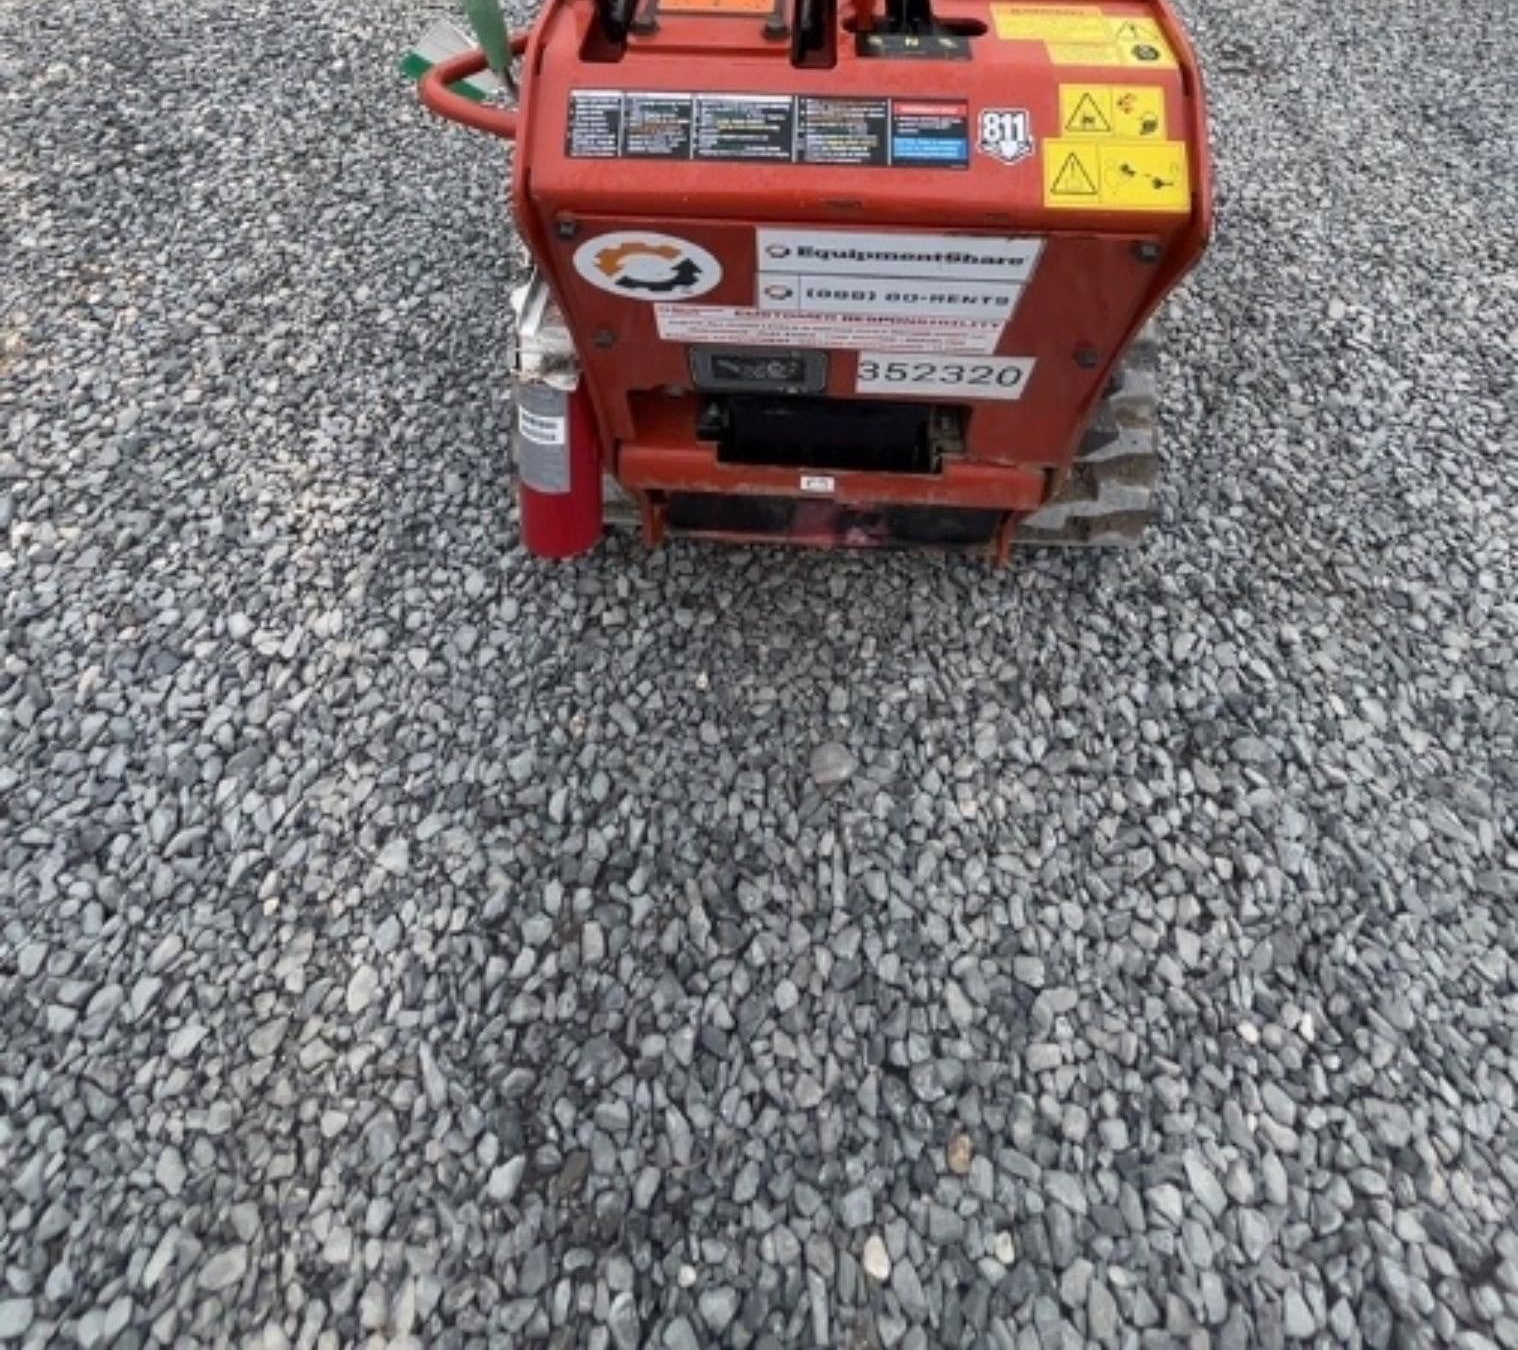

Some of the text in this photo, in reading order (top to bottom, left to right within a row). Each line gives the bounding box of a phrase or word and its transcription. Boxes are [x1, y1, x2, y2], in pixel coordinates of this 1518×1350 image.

[982, 112, 1025, 142] 811
[797, 245, 1025, 266] EquipmentShare
[857, 359, 1024, 387] 352320
